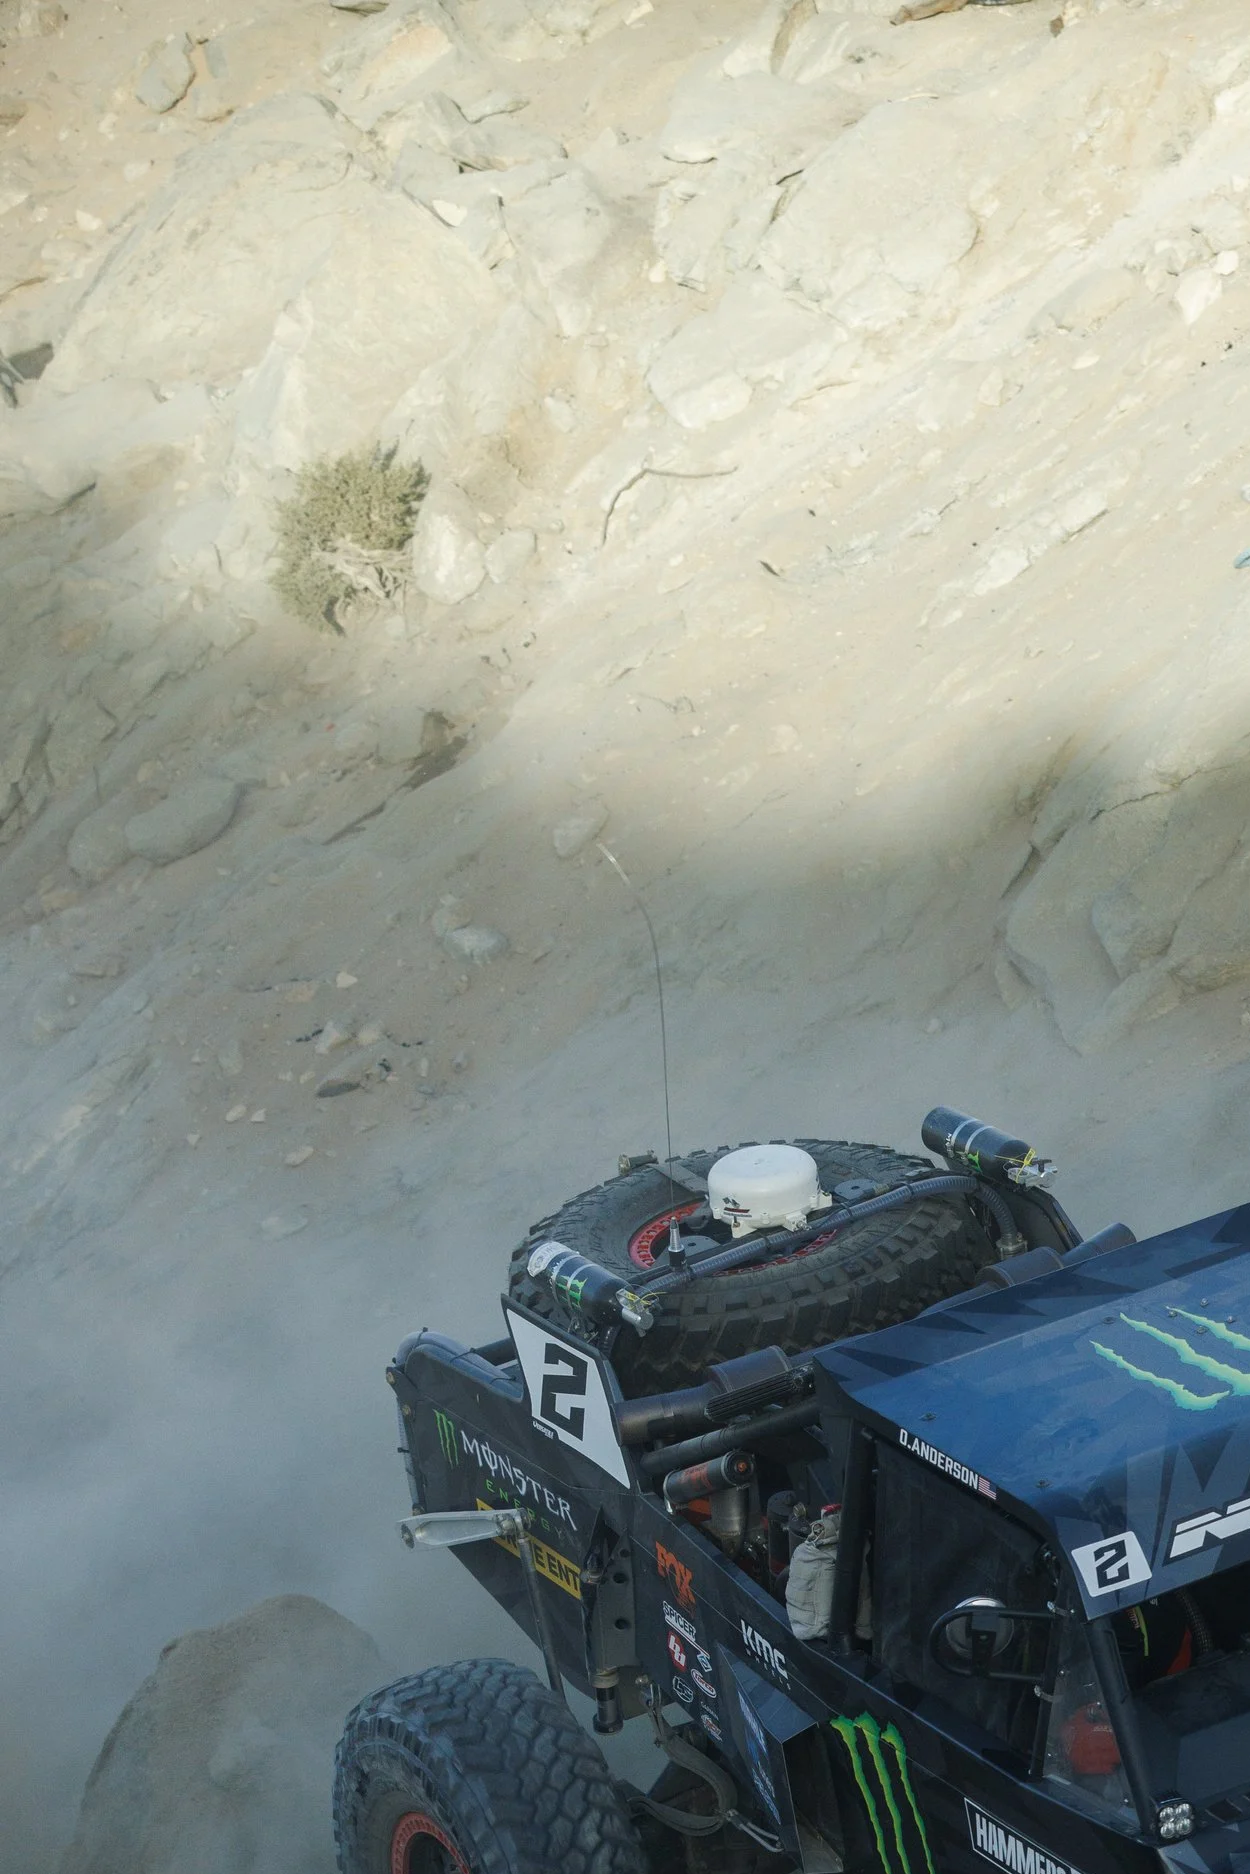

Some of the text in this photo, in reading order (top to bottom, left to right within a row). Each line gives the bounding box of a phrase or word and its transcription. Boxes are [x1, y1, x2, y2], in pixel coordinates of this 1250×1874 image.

[540, 1342, 588, 1441] 2
[460, 1429, 578, 1532] MONSTER
[485, 1478, 563, 1540] ENERGY
[655, 1540, 697, 1609] FOX
[1091, 1539, 1132, 1589] 2
[663, 1602, 697, 1642] SPICER
